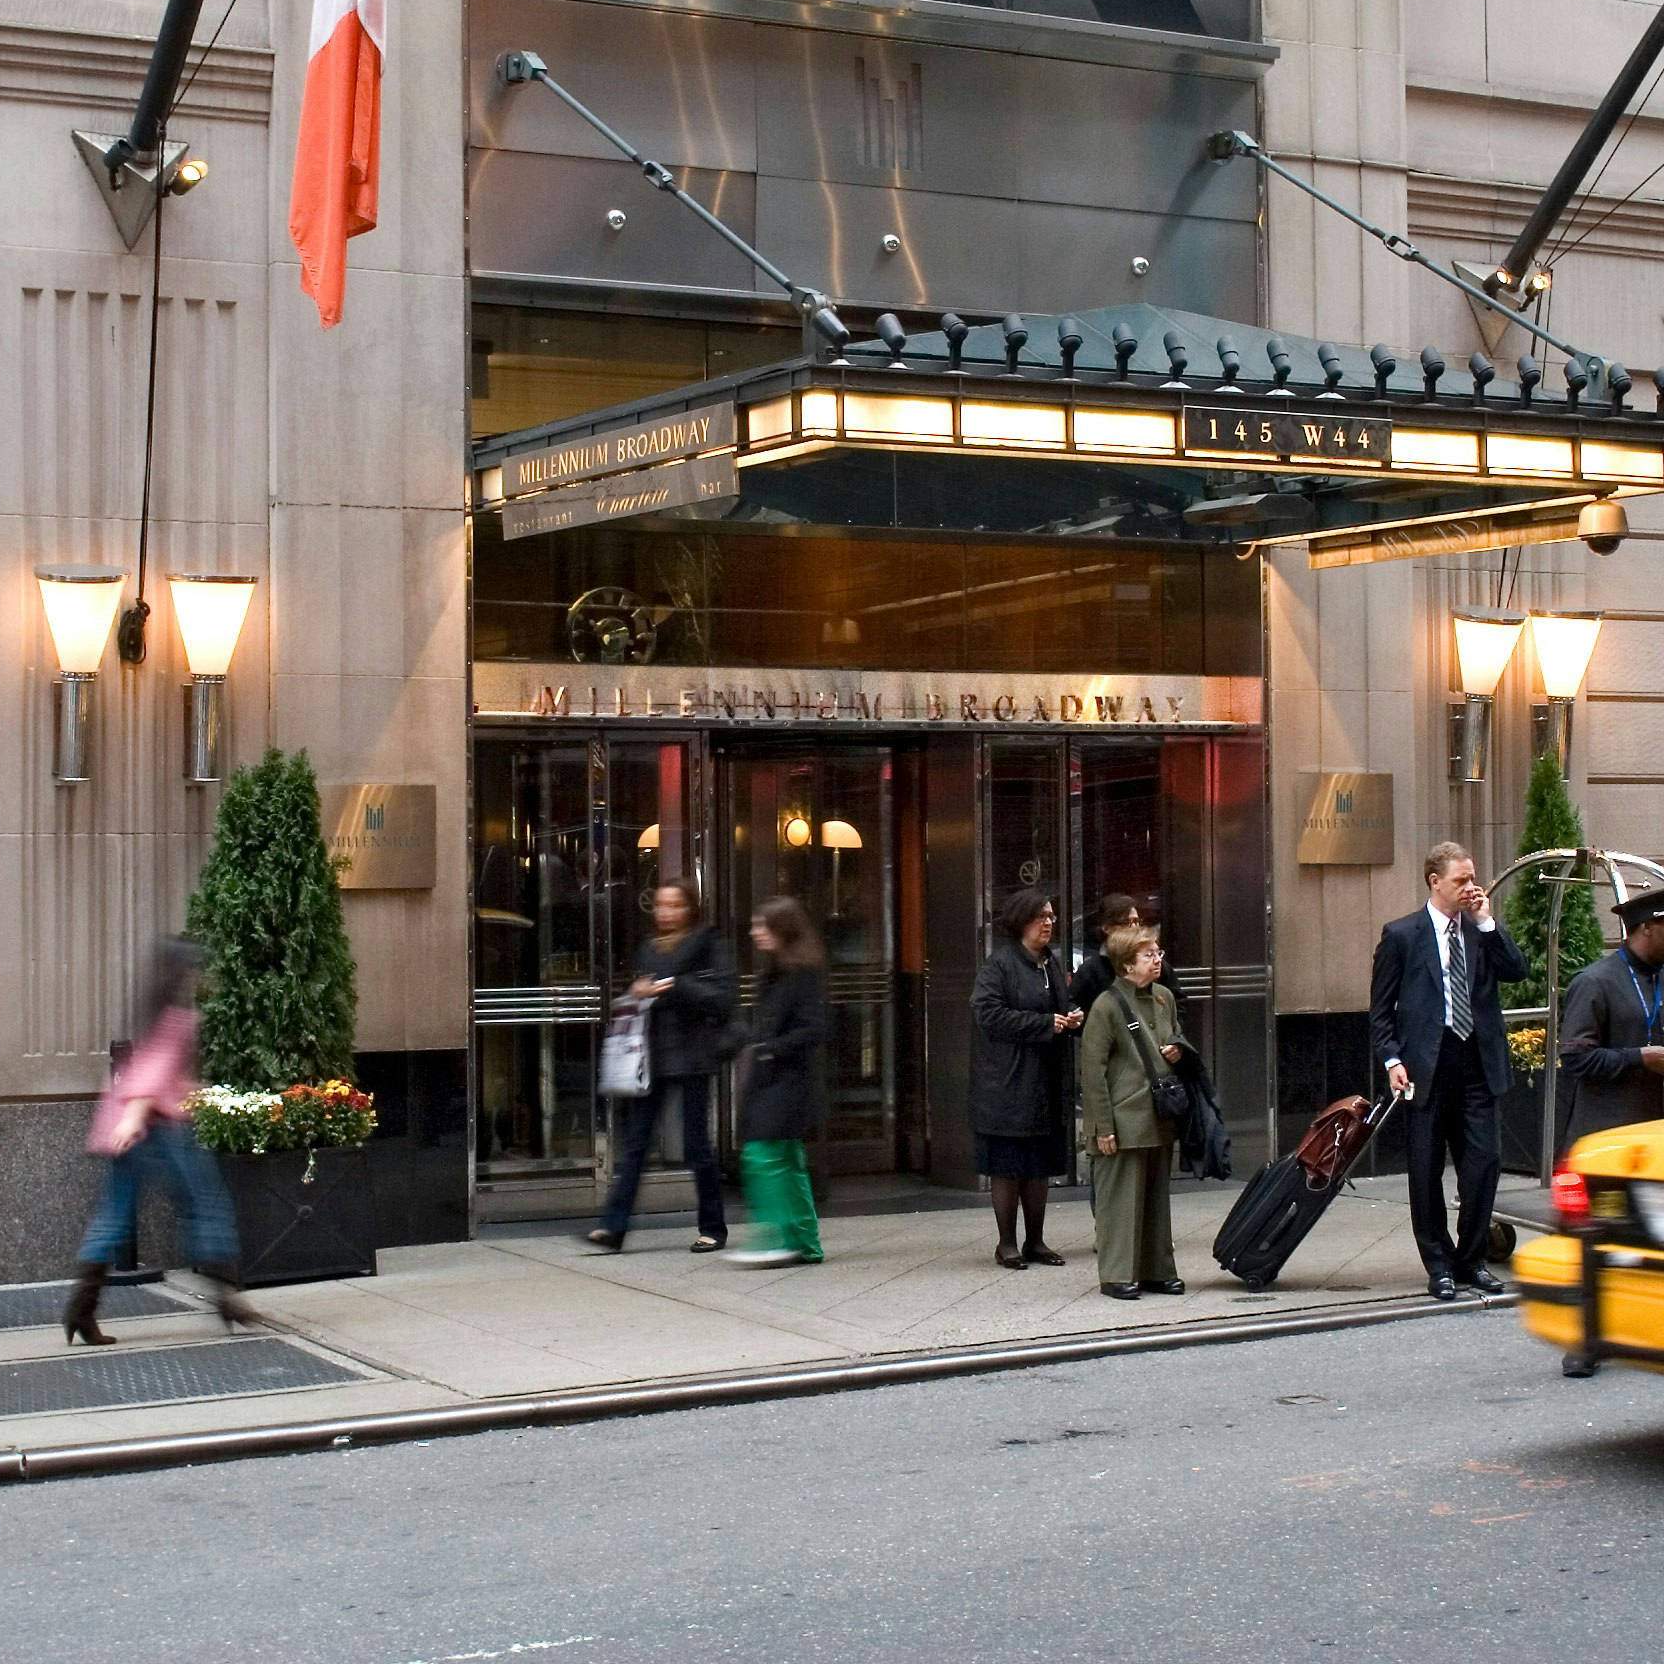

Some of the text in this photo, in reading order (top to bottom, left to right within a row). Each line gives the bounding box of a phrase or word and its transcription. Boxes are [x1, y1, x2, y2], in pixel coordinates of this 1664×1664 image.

[1209, 418, 1273, 444] 145
[519, 416, 711, 486] MILLENNIUM BROADWAY
[537, 685, 1184, 723] MILLENNIUM BROADWAY
